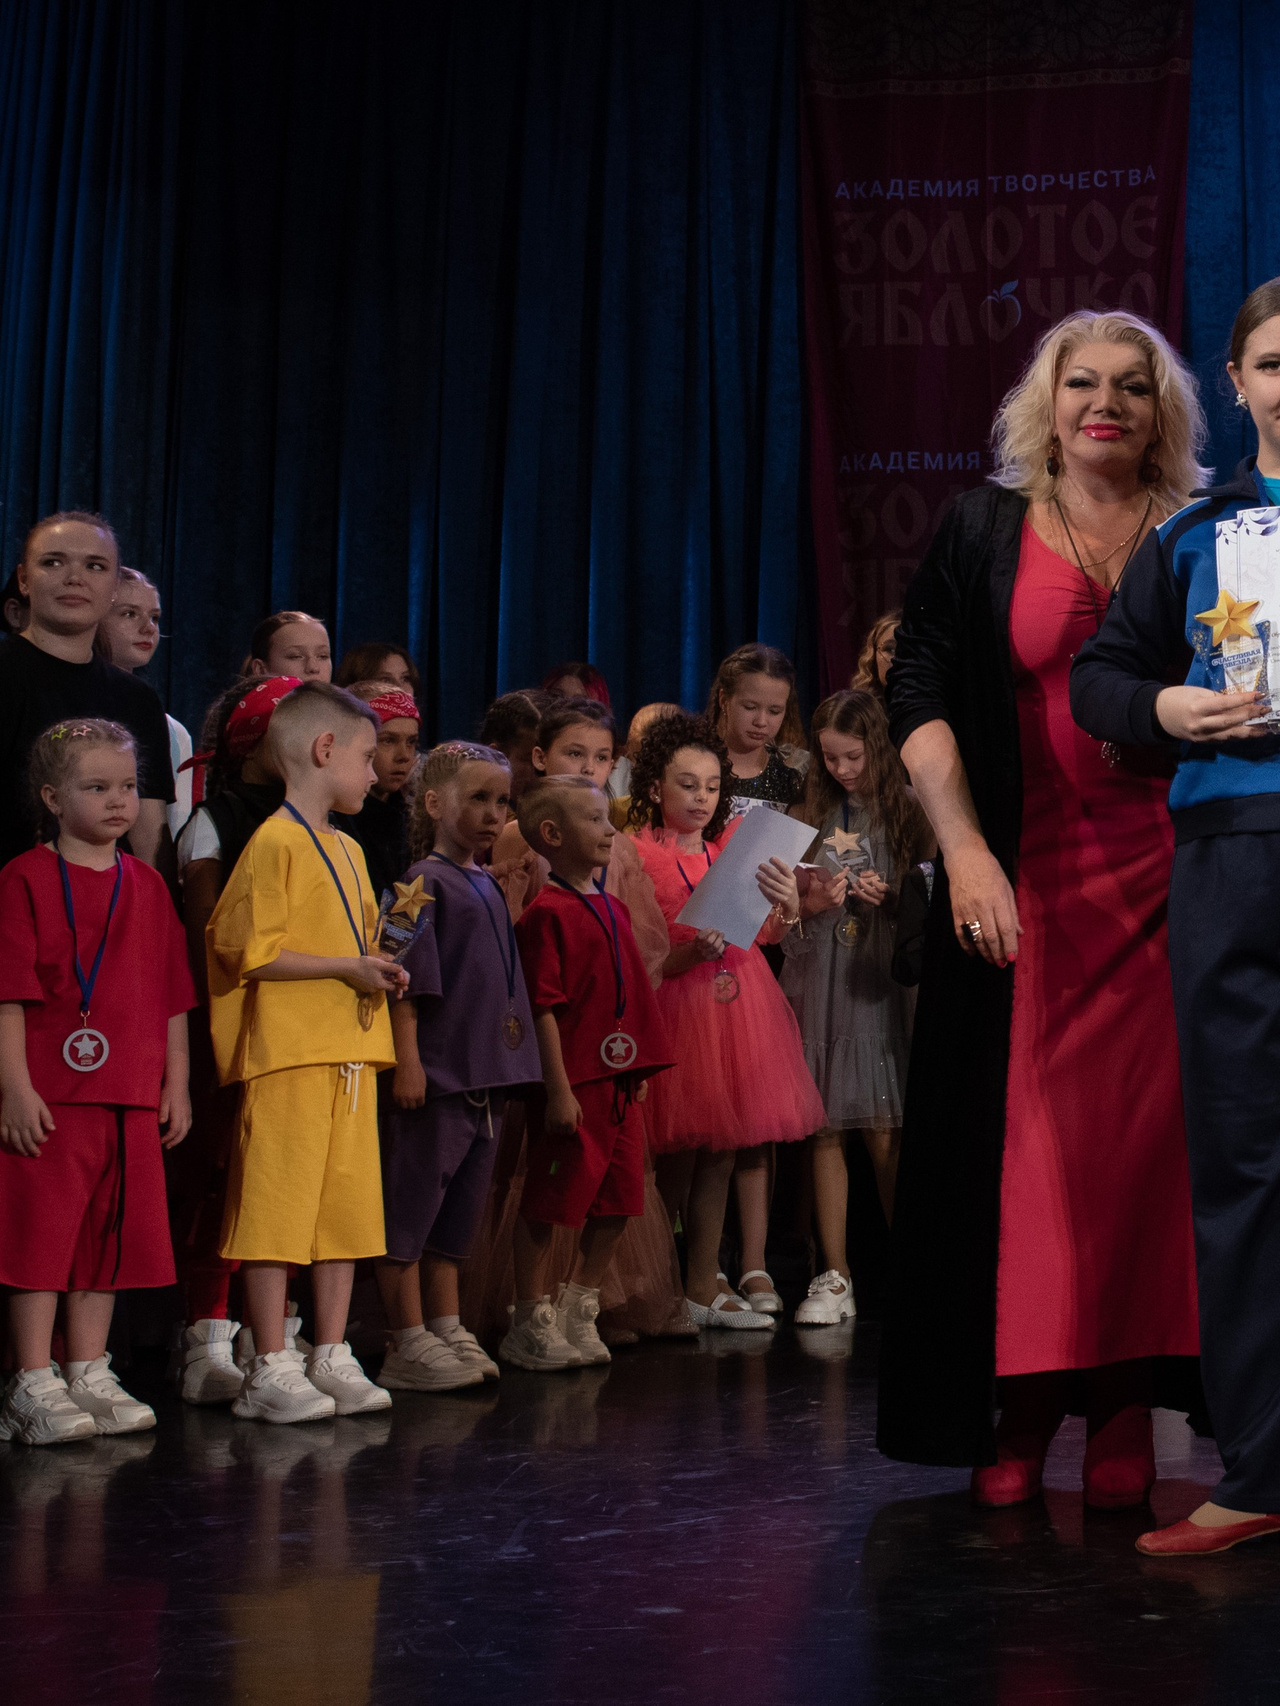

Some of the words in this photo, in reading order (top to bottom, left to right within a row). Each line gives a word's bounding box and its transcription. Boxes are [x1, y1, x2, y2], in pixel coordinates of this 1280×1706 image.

[835, 179, 980, 200] АКАДЕМИЯ
[988, 165, 1157, 194] ТВОРЧЕСТВА
[839, 451, 981, 474] АКАДЕМИЯ
[1212, 649, 1261, 666] СЧАСТЛИВАЯ
